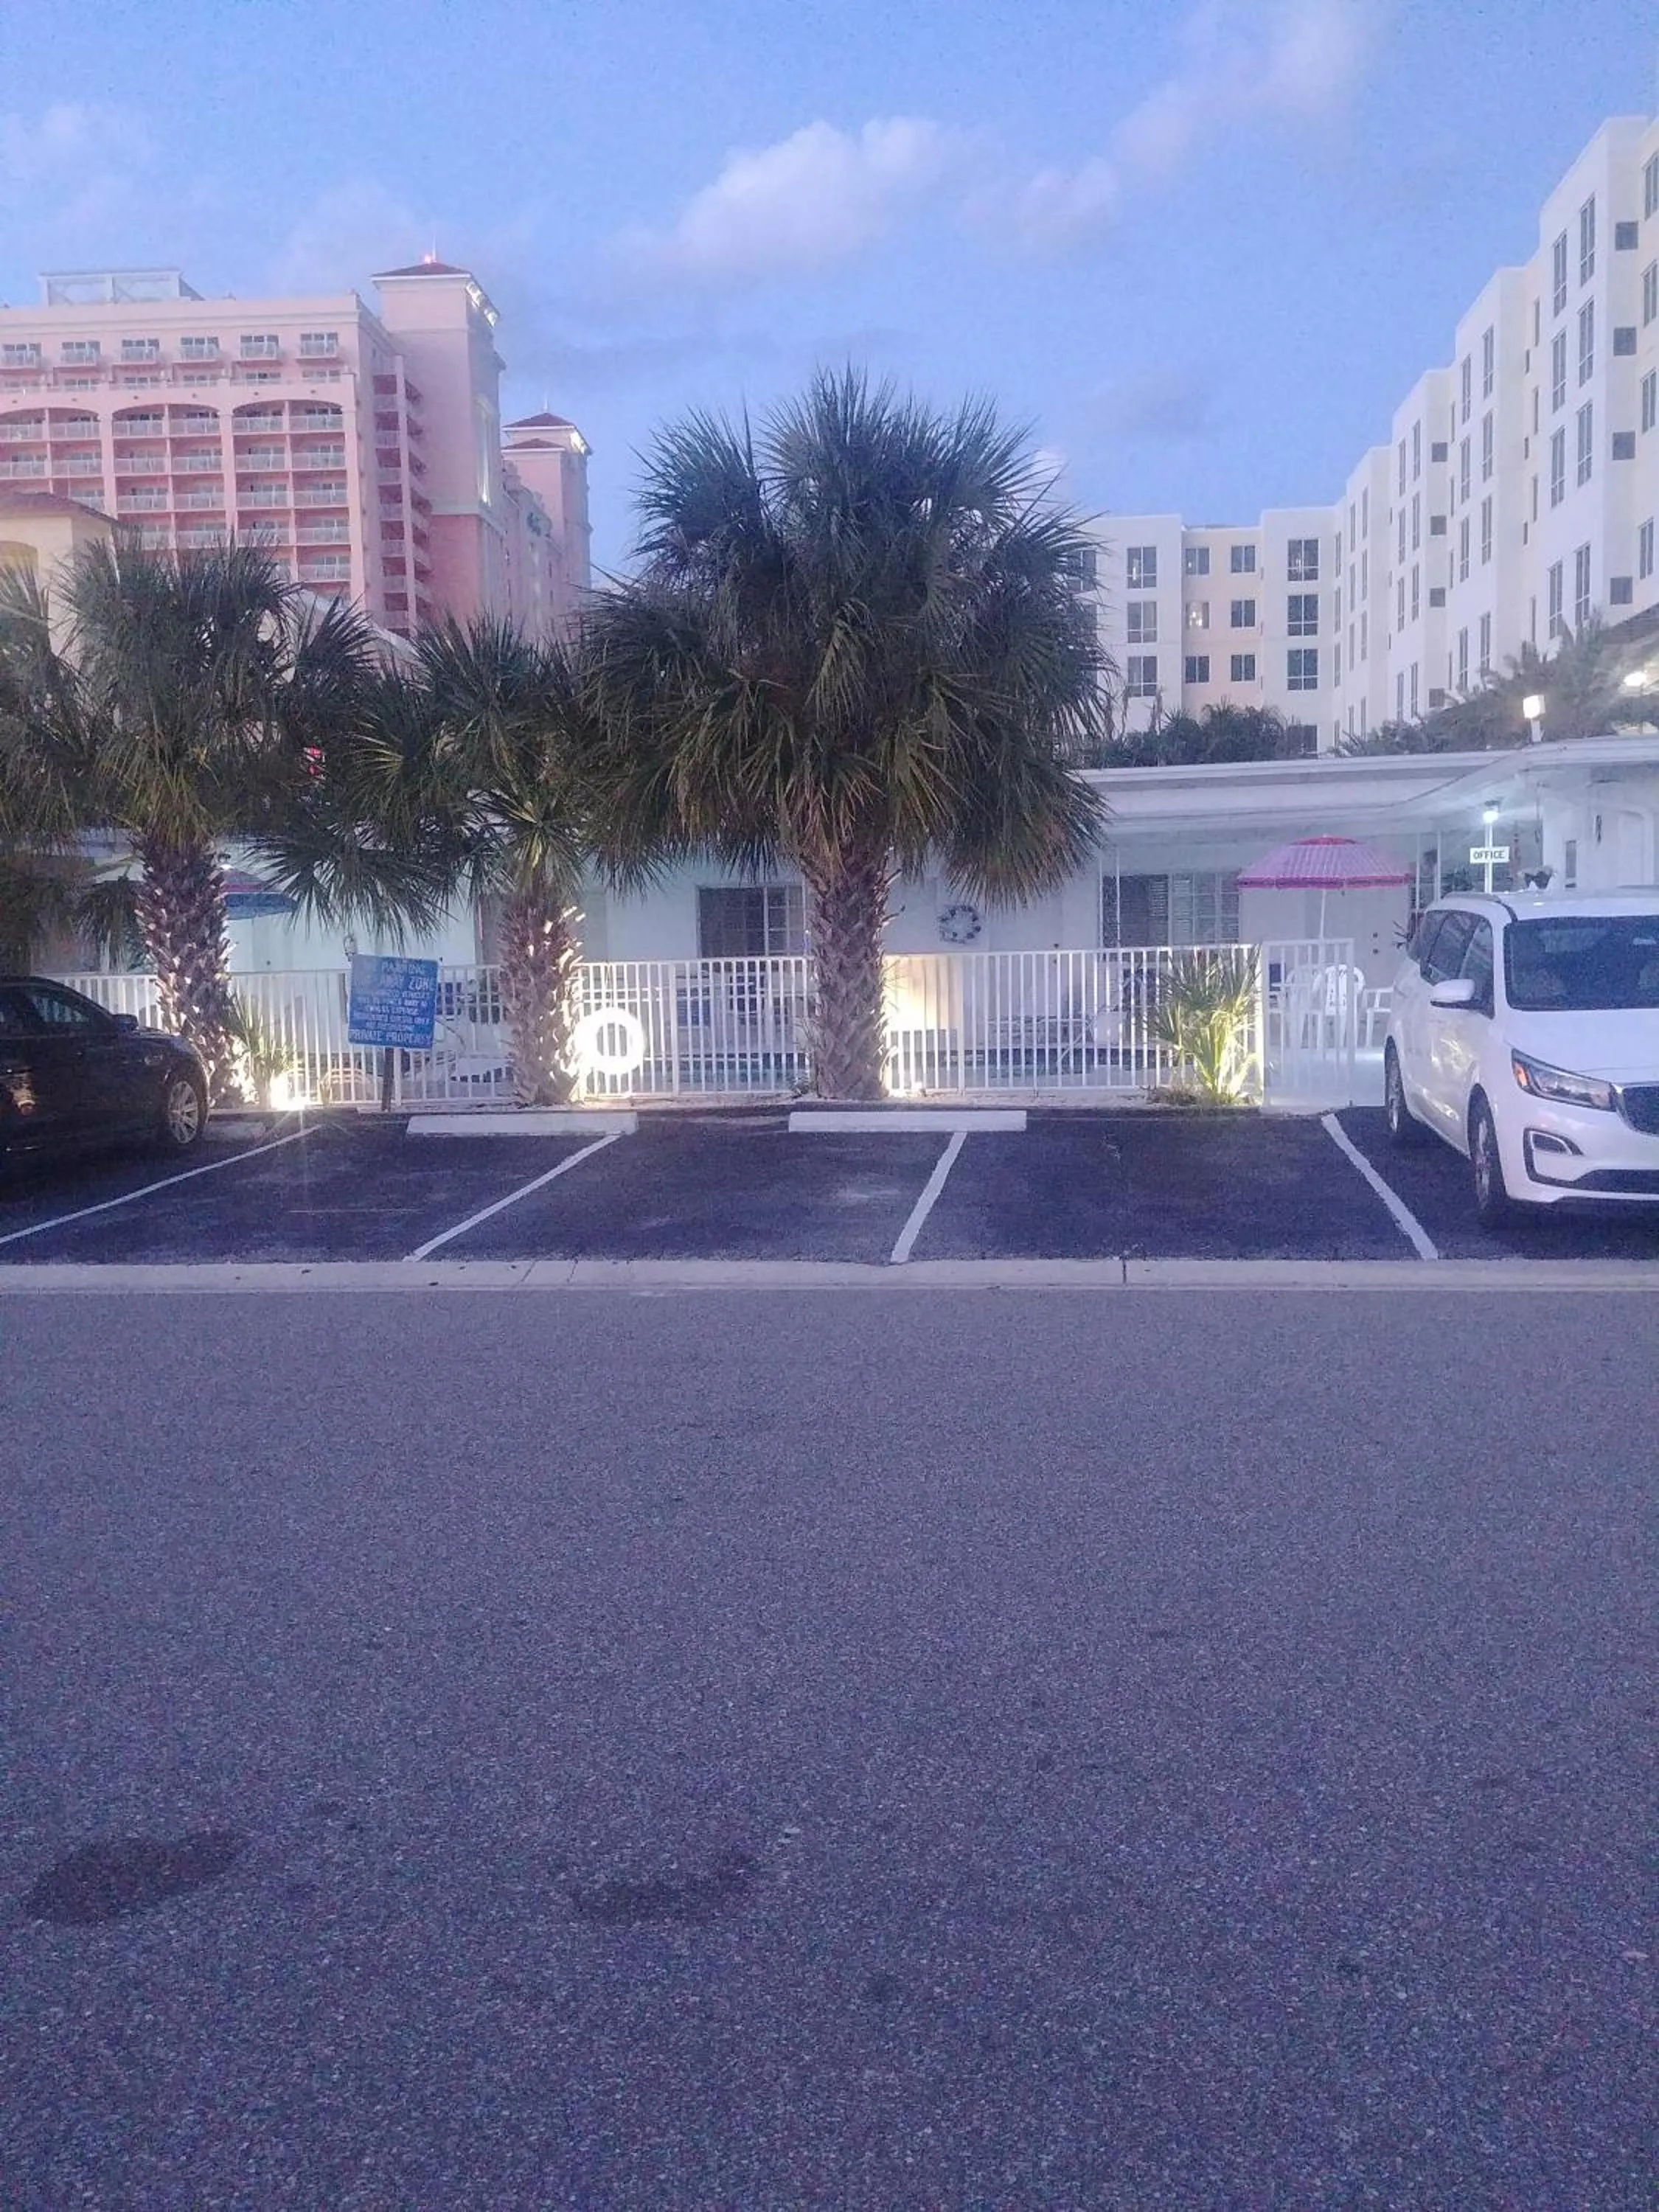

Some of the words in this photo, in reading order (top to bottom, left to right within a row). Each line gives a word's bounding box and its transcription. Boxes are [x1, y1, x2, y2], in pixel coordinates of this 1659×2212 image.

[1473, 850, 1505, 860] OFFICE
[408, 975, 435, 991] ZONE
[349, 1029, 383, 1042] PRIVATE
